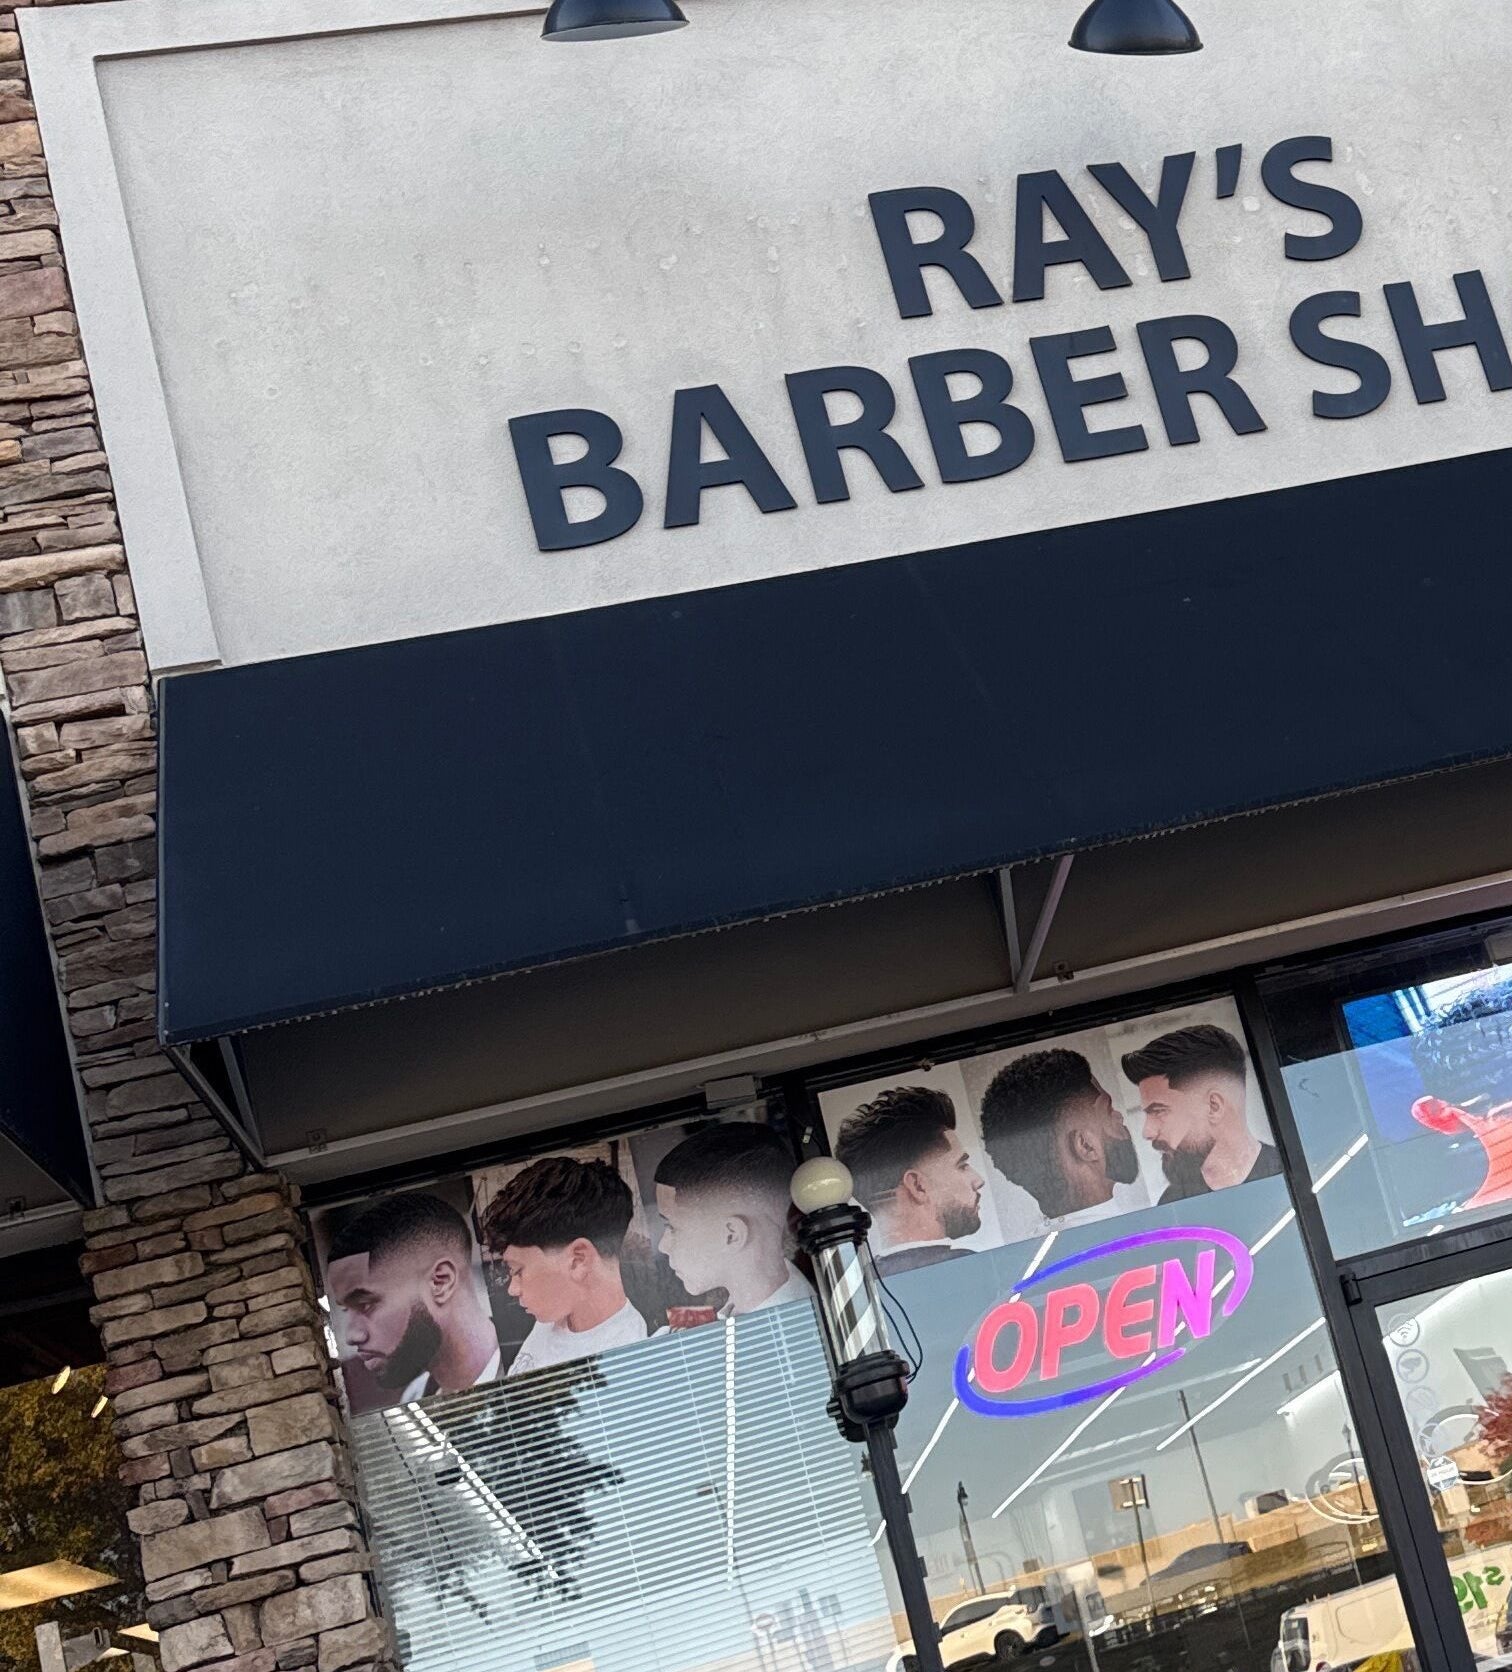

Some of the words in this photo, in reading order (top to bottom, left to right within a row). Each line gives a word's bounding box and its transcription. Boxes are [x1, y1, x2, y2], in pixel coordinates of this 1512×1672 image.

[868, 136, 1364, 319] RAY'S
[508, 313, 1268, 552] BARBER
[974, 1249, 1216, 1394] OPEN
